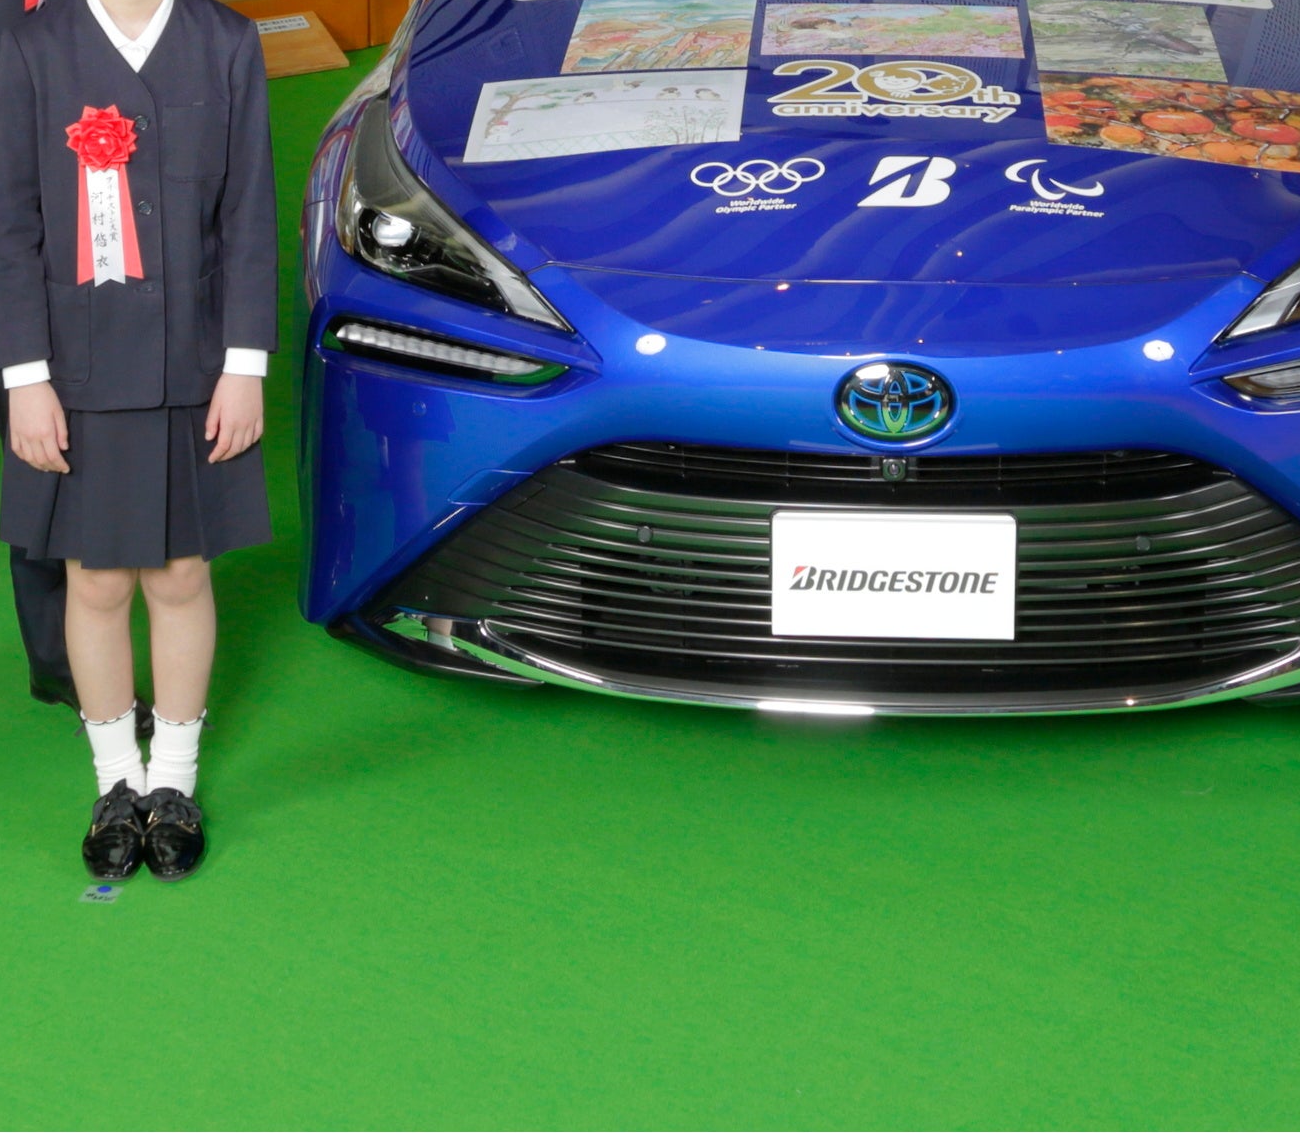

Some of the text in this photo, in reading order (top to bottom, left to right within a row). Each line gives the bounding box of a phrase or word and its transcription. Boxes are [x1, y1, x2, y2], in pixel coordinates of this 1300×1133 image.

[771, 102, 1017, 123] anniversary
[729, 197, 785, 207] Worldwide
[1029, 200, 1085, 210] Worldwide
[715, 203, 798, 214] Olympic Partner
[1009, 204, 1105, 218] Paralympic Partner
[788, 565, 999, 595] BRIDGESTONE
